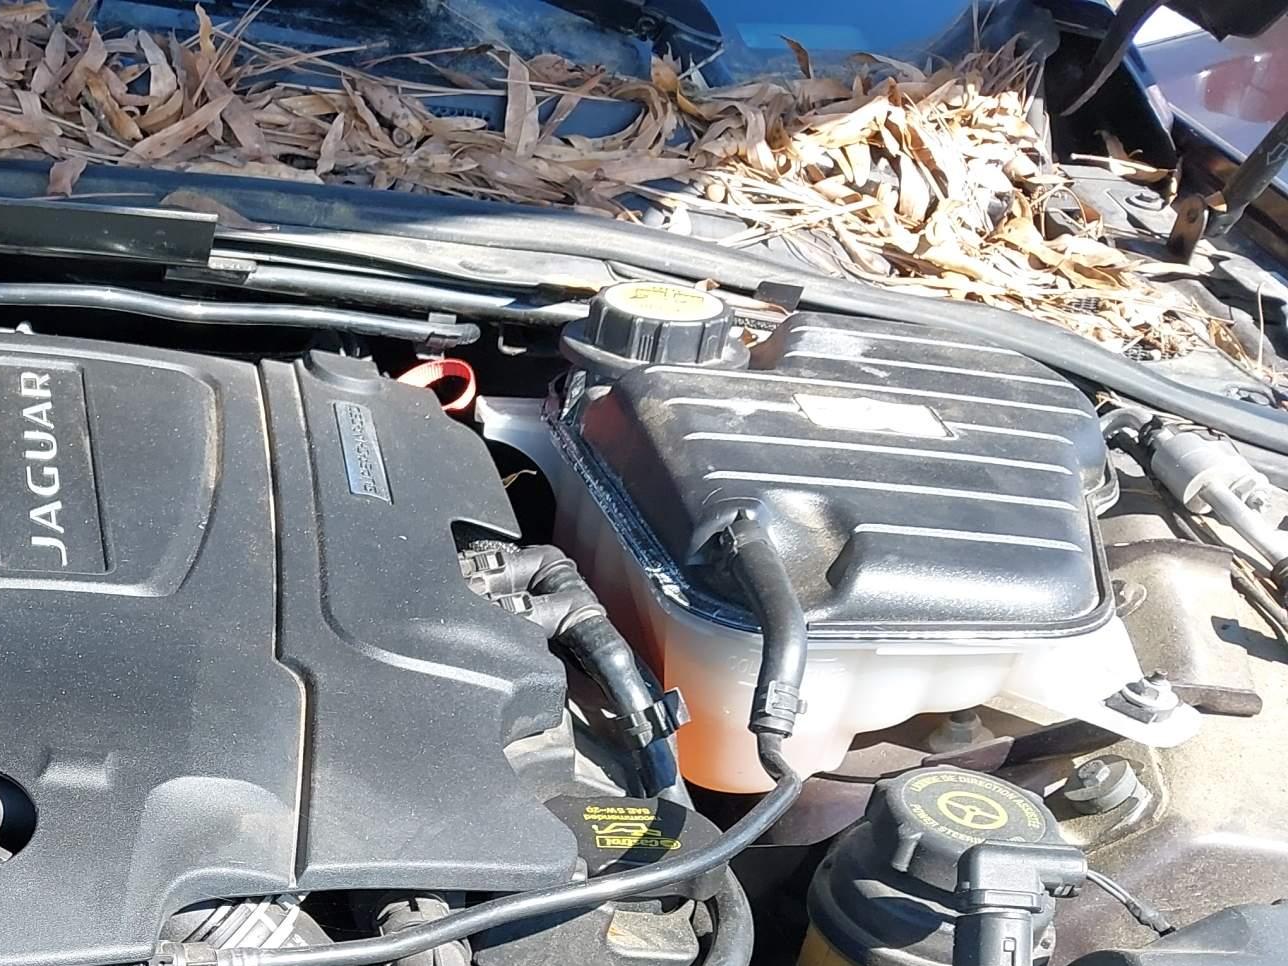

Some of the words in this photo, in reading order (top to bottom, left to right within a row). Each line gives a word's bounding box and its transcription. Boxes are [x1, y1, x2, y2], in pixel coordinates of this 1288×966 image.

[20, 371, 67, 567] JAGUAR
[959, 775, 1016, 800] DIRECTION
[910, 803, 939, 827] POWER
[938, 825, 986, 846] STEERIN
[604, 837, 660, 847] Castrol
